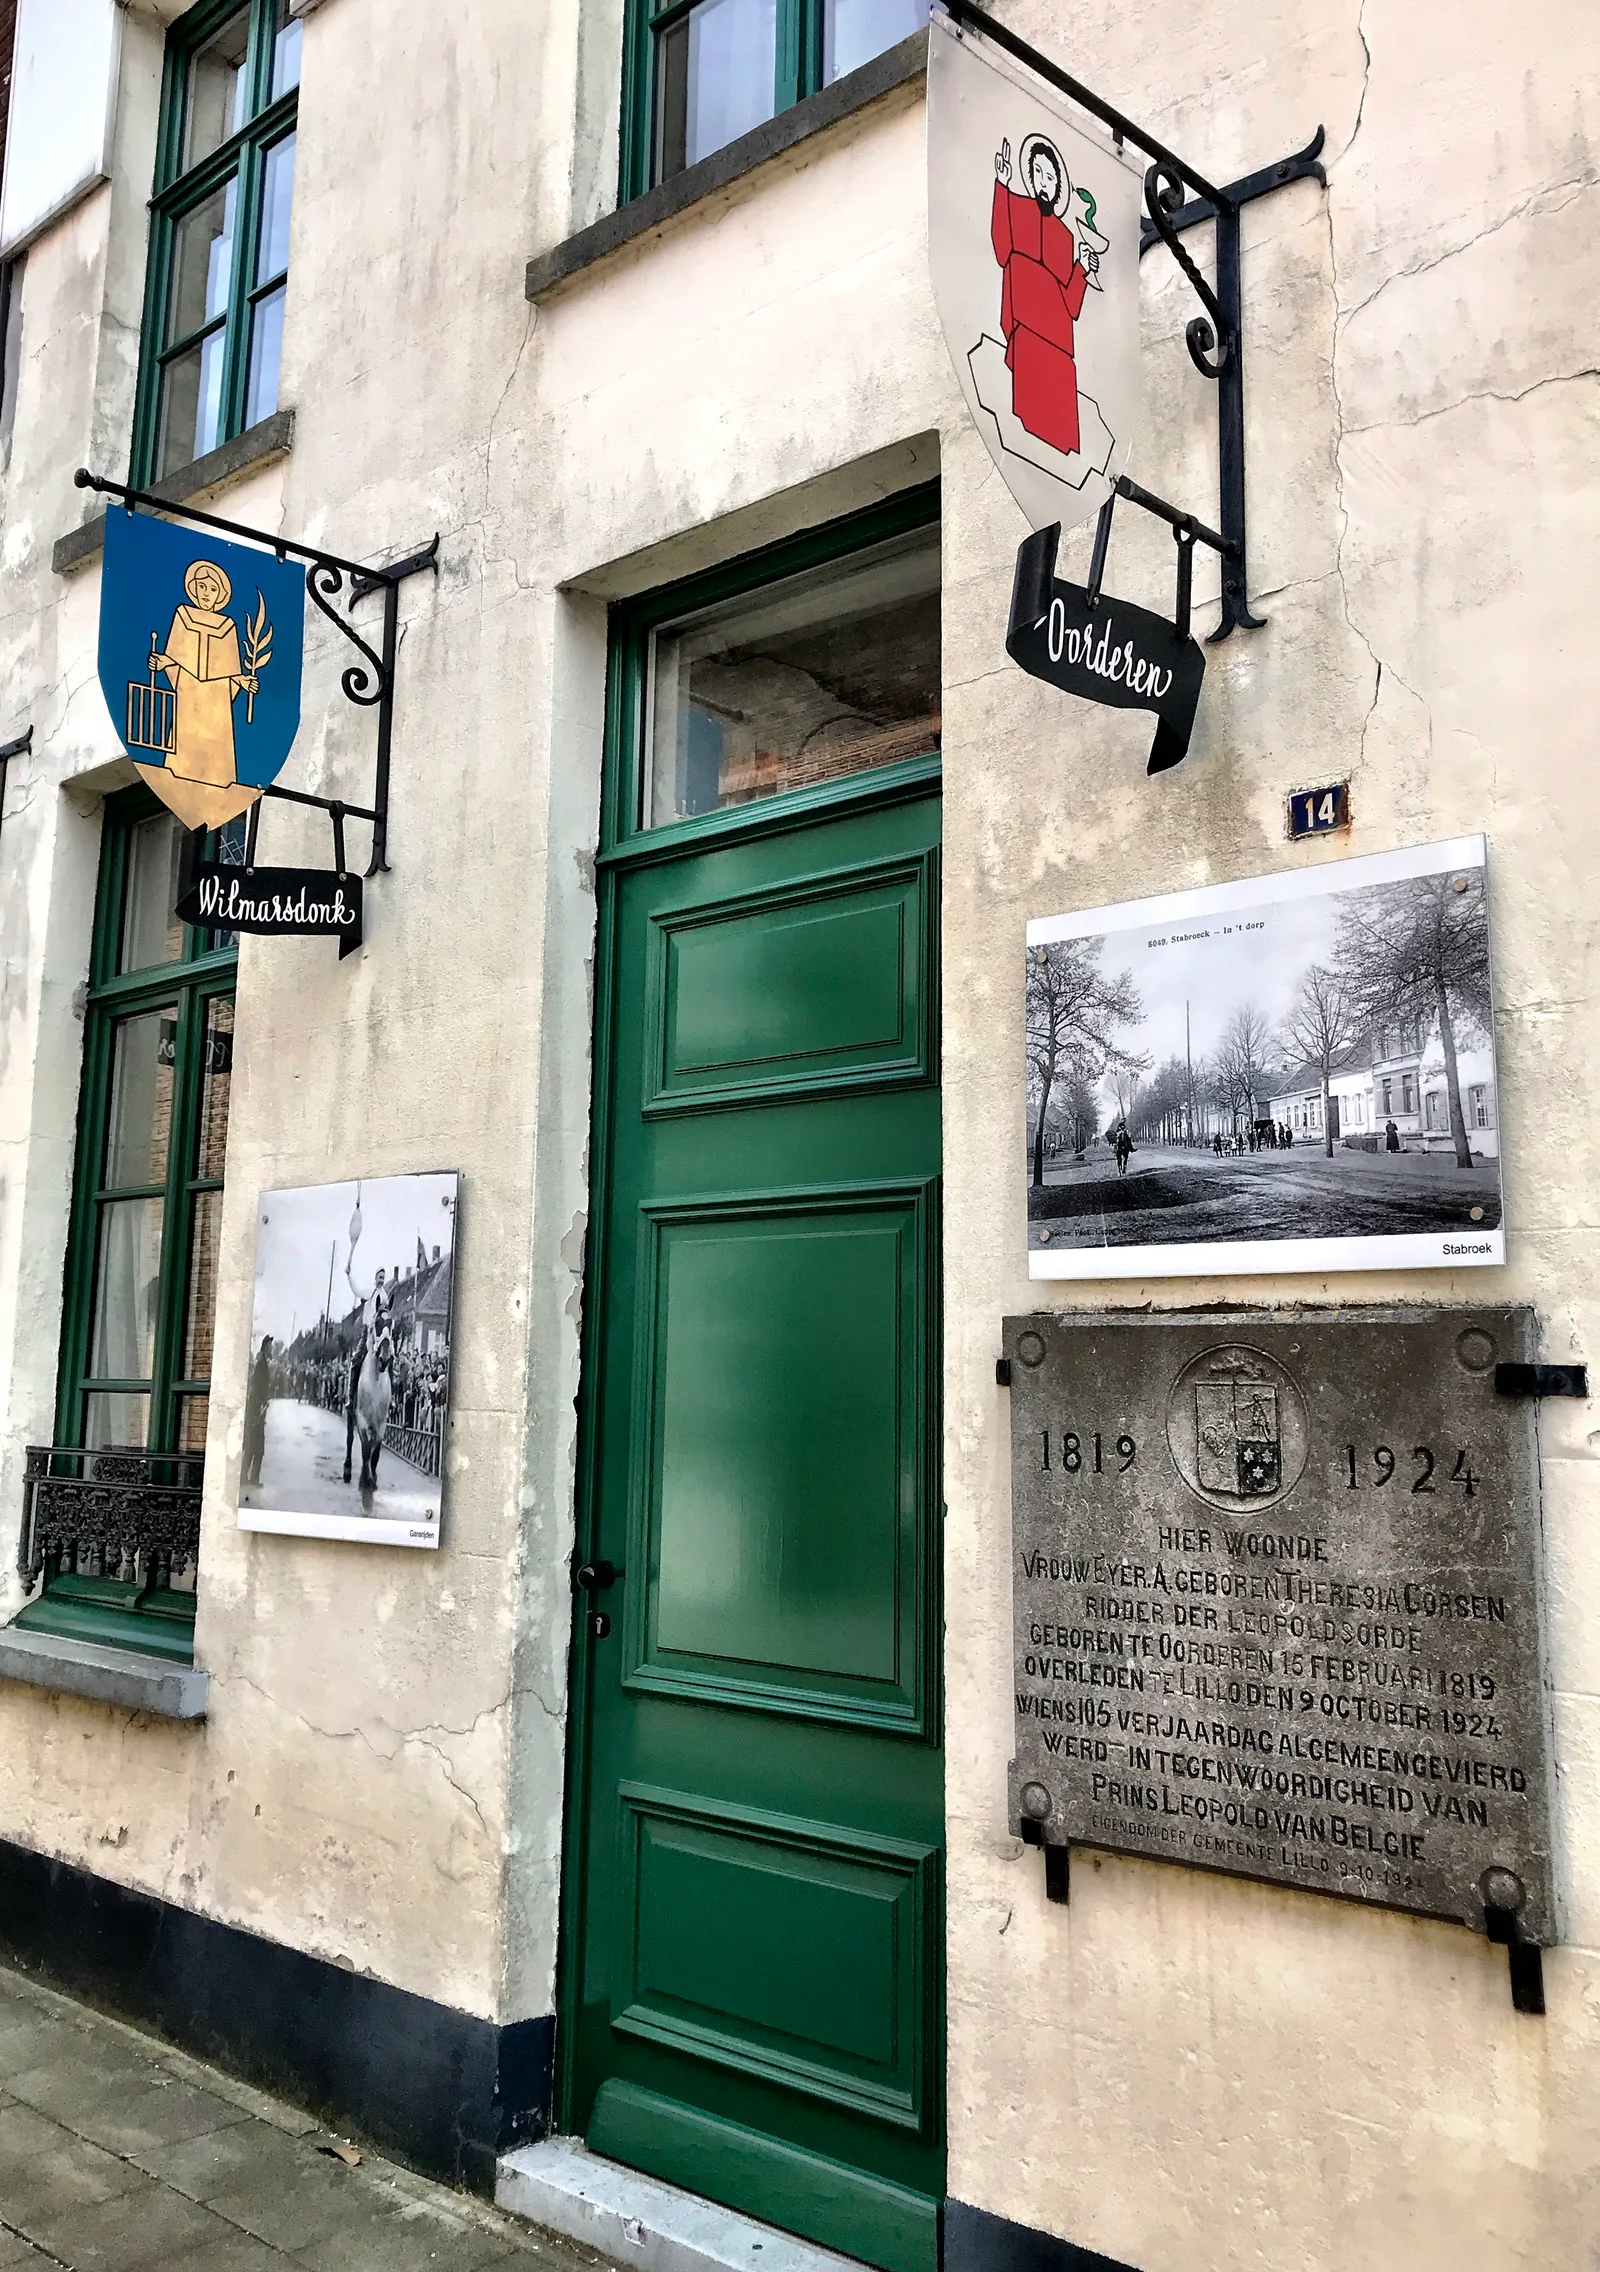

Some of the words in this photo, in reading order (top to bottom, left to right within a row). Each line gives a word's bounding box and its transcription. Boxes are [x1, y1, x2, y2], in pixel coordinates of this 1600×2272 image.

[1033, 598, 1173, 697] Oorderen
[1305, 792, 1336, 828] 14
[199, 875, 355, 925] Wilmarsdonk
[1245, 921, 1265, 931] dorp
[1442, 1243, 1493, 1255] Stabroek
[1039, 1430, 1136, 1474] 1819
[1343, 1444, 1481, 1496] 1924
[1159, 1526, 1212, 1553] HIER
[1223, 1530, 1329, 1563] WOONDE
[1020, 1549, 1090, 1583] VROUW
[1174, 1570, 1279, 1601] GEBOREN
[1275, 1567, 1402, 1614] THERESIA
[1403, 1582, 1506, 1623] CORSEN
[1086, 1596, 1165, 1626] RIDDER
[1173, 1604, 1218, 1631] DER
[1030, 1623, 1124, 1656] GEBOREN
[1127, 1633, 1154, 1658] TE
[1159, 1632, 1274, 1675] OORDEREN
[1283, 1650, 1304, 1676] 15
[1310, 1655, 1433, 1694] FEBRUARI
[1437, 1669, 1497, 1701] 1819
[1024, 1655, 1144, 1693] OVERLEDEN
[1150, 1670, 1176, 1696] TE
[1179, 1668, 1241, 1705] LILLO
[1245, 1683, 1294, 1712] DEN
[1299, 1690, 1315, 1713] 9
[1319, 1692, 1431, 1731] OCTOBER
[1440, 1709, 1503, 1742] 1924
[1016, 1694, 1075, 1725] WIENS
[1077, 1697, 1112, 1728] 105
[1117, 1708, 1275, 1755] VERJAARDAG
[1278, 1733, 1409, 1776] ALGEMEEN
[1411, 1753, 1528, 1794] GEVIERD
[1091, 1772, 1159, 1812] PRINS
[1160, 1785, 1269, 1831] LEOPOLD
[1273, 1809, 1327, 1844] VAN
[1329, 1813, 1427, 1862] BELGIE
[1421, 1791, 1490, 1828] VAN
[1092, 1815, 1158, 1839] EIGENDOM
[1160, 1827, 1187, 1846] DER
[1193, 1833, 1276, 1863] GEMEENTE
[1281, 1846, 1330, 1873] LILLO
